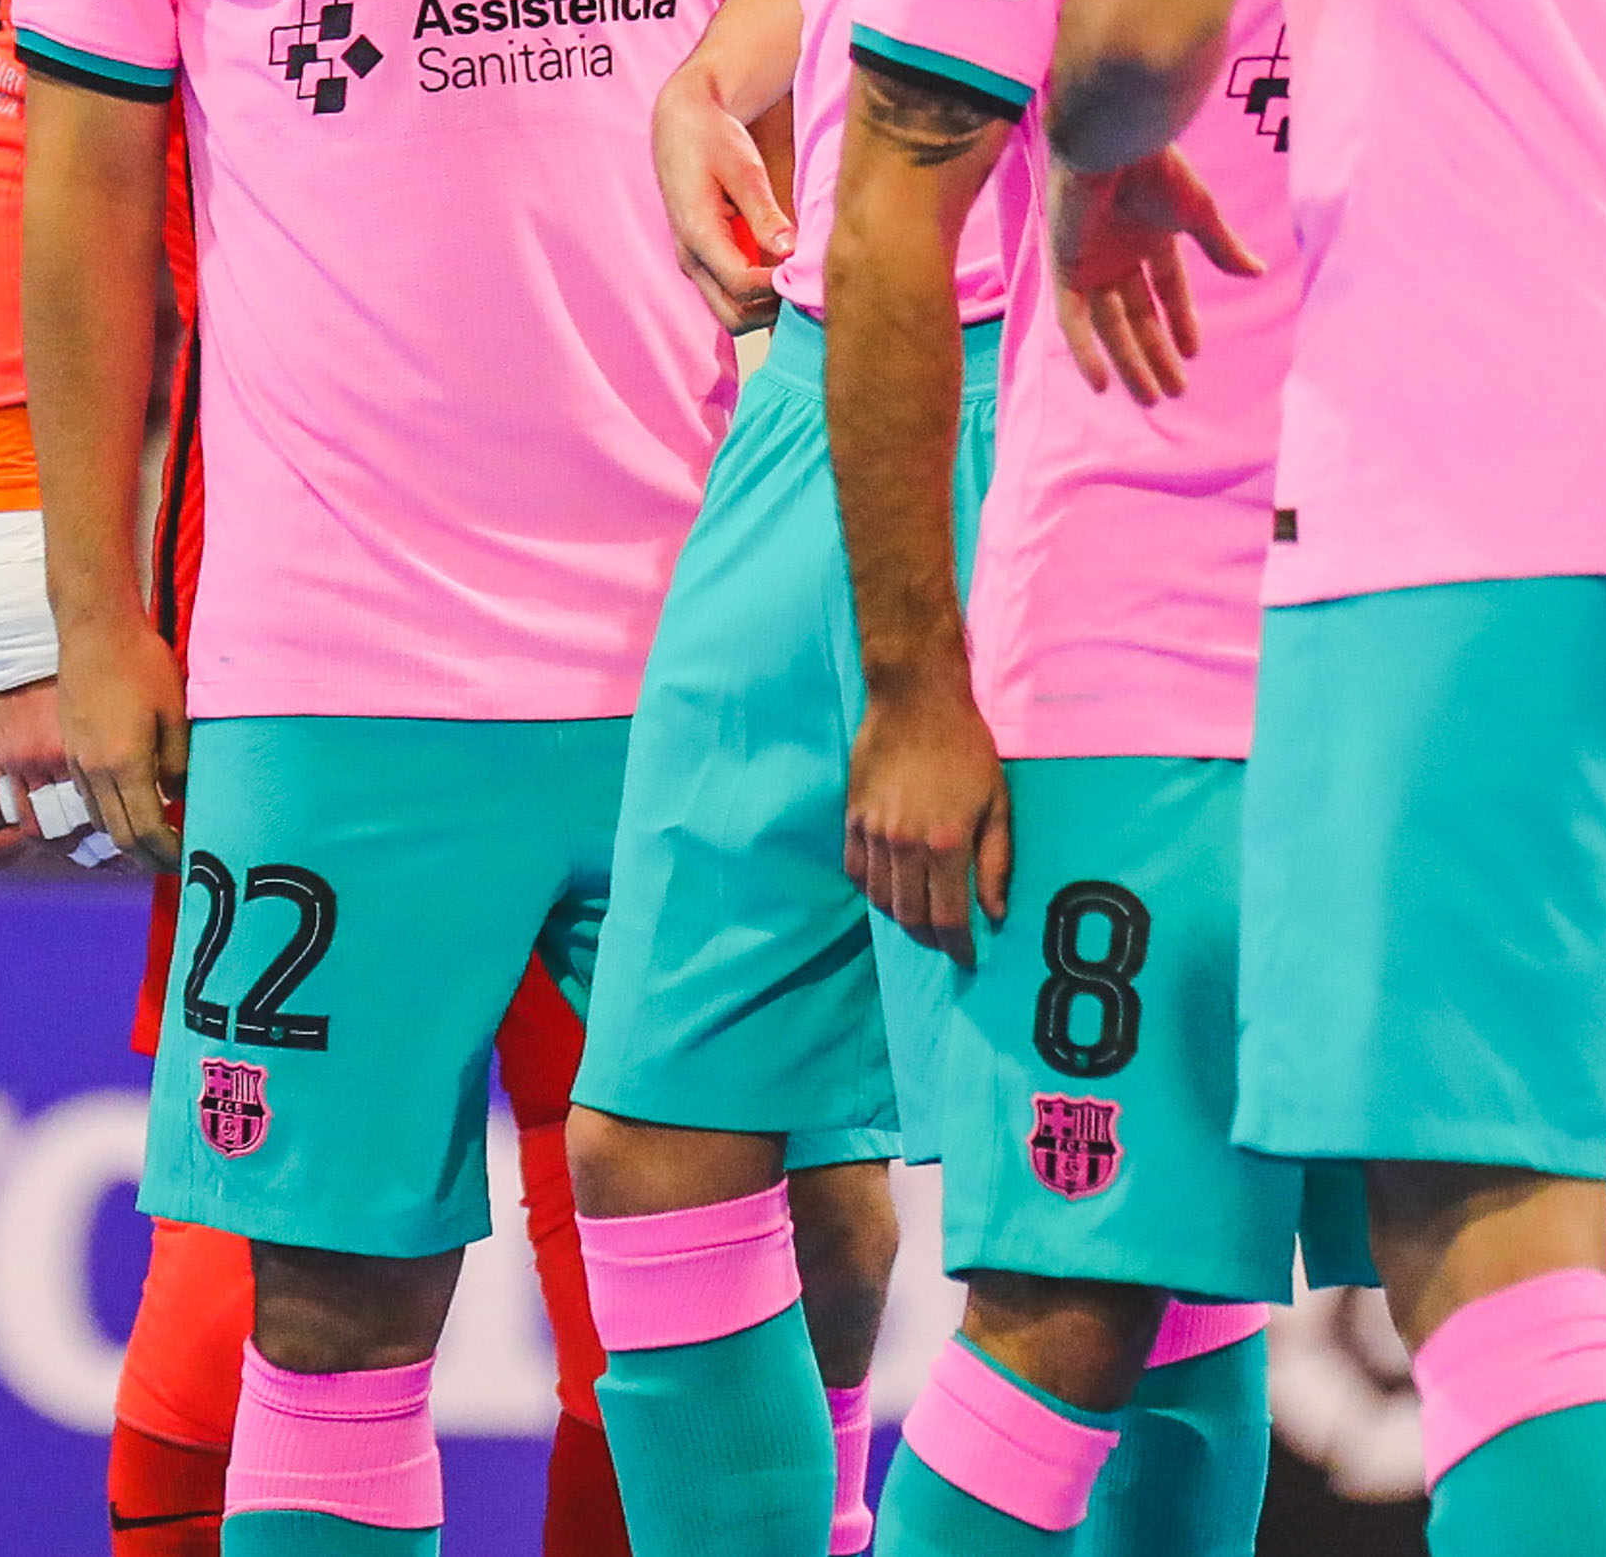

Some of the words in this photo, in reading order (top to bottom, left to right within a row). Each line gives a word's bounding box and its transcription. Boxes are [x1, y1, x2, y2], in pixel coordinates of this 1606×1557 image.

[417, 33, 614, 93] Sanitària
[183, 849, 337, 1053] 22
[1032, 880, 1151, 1079] 8
